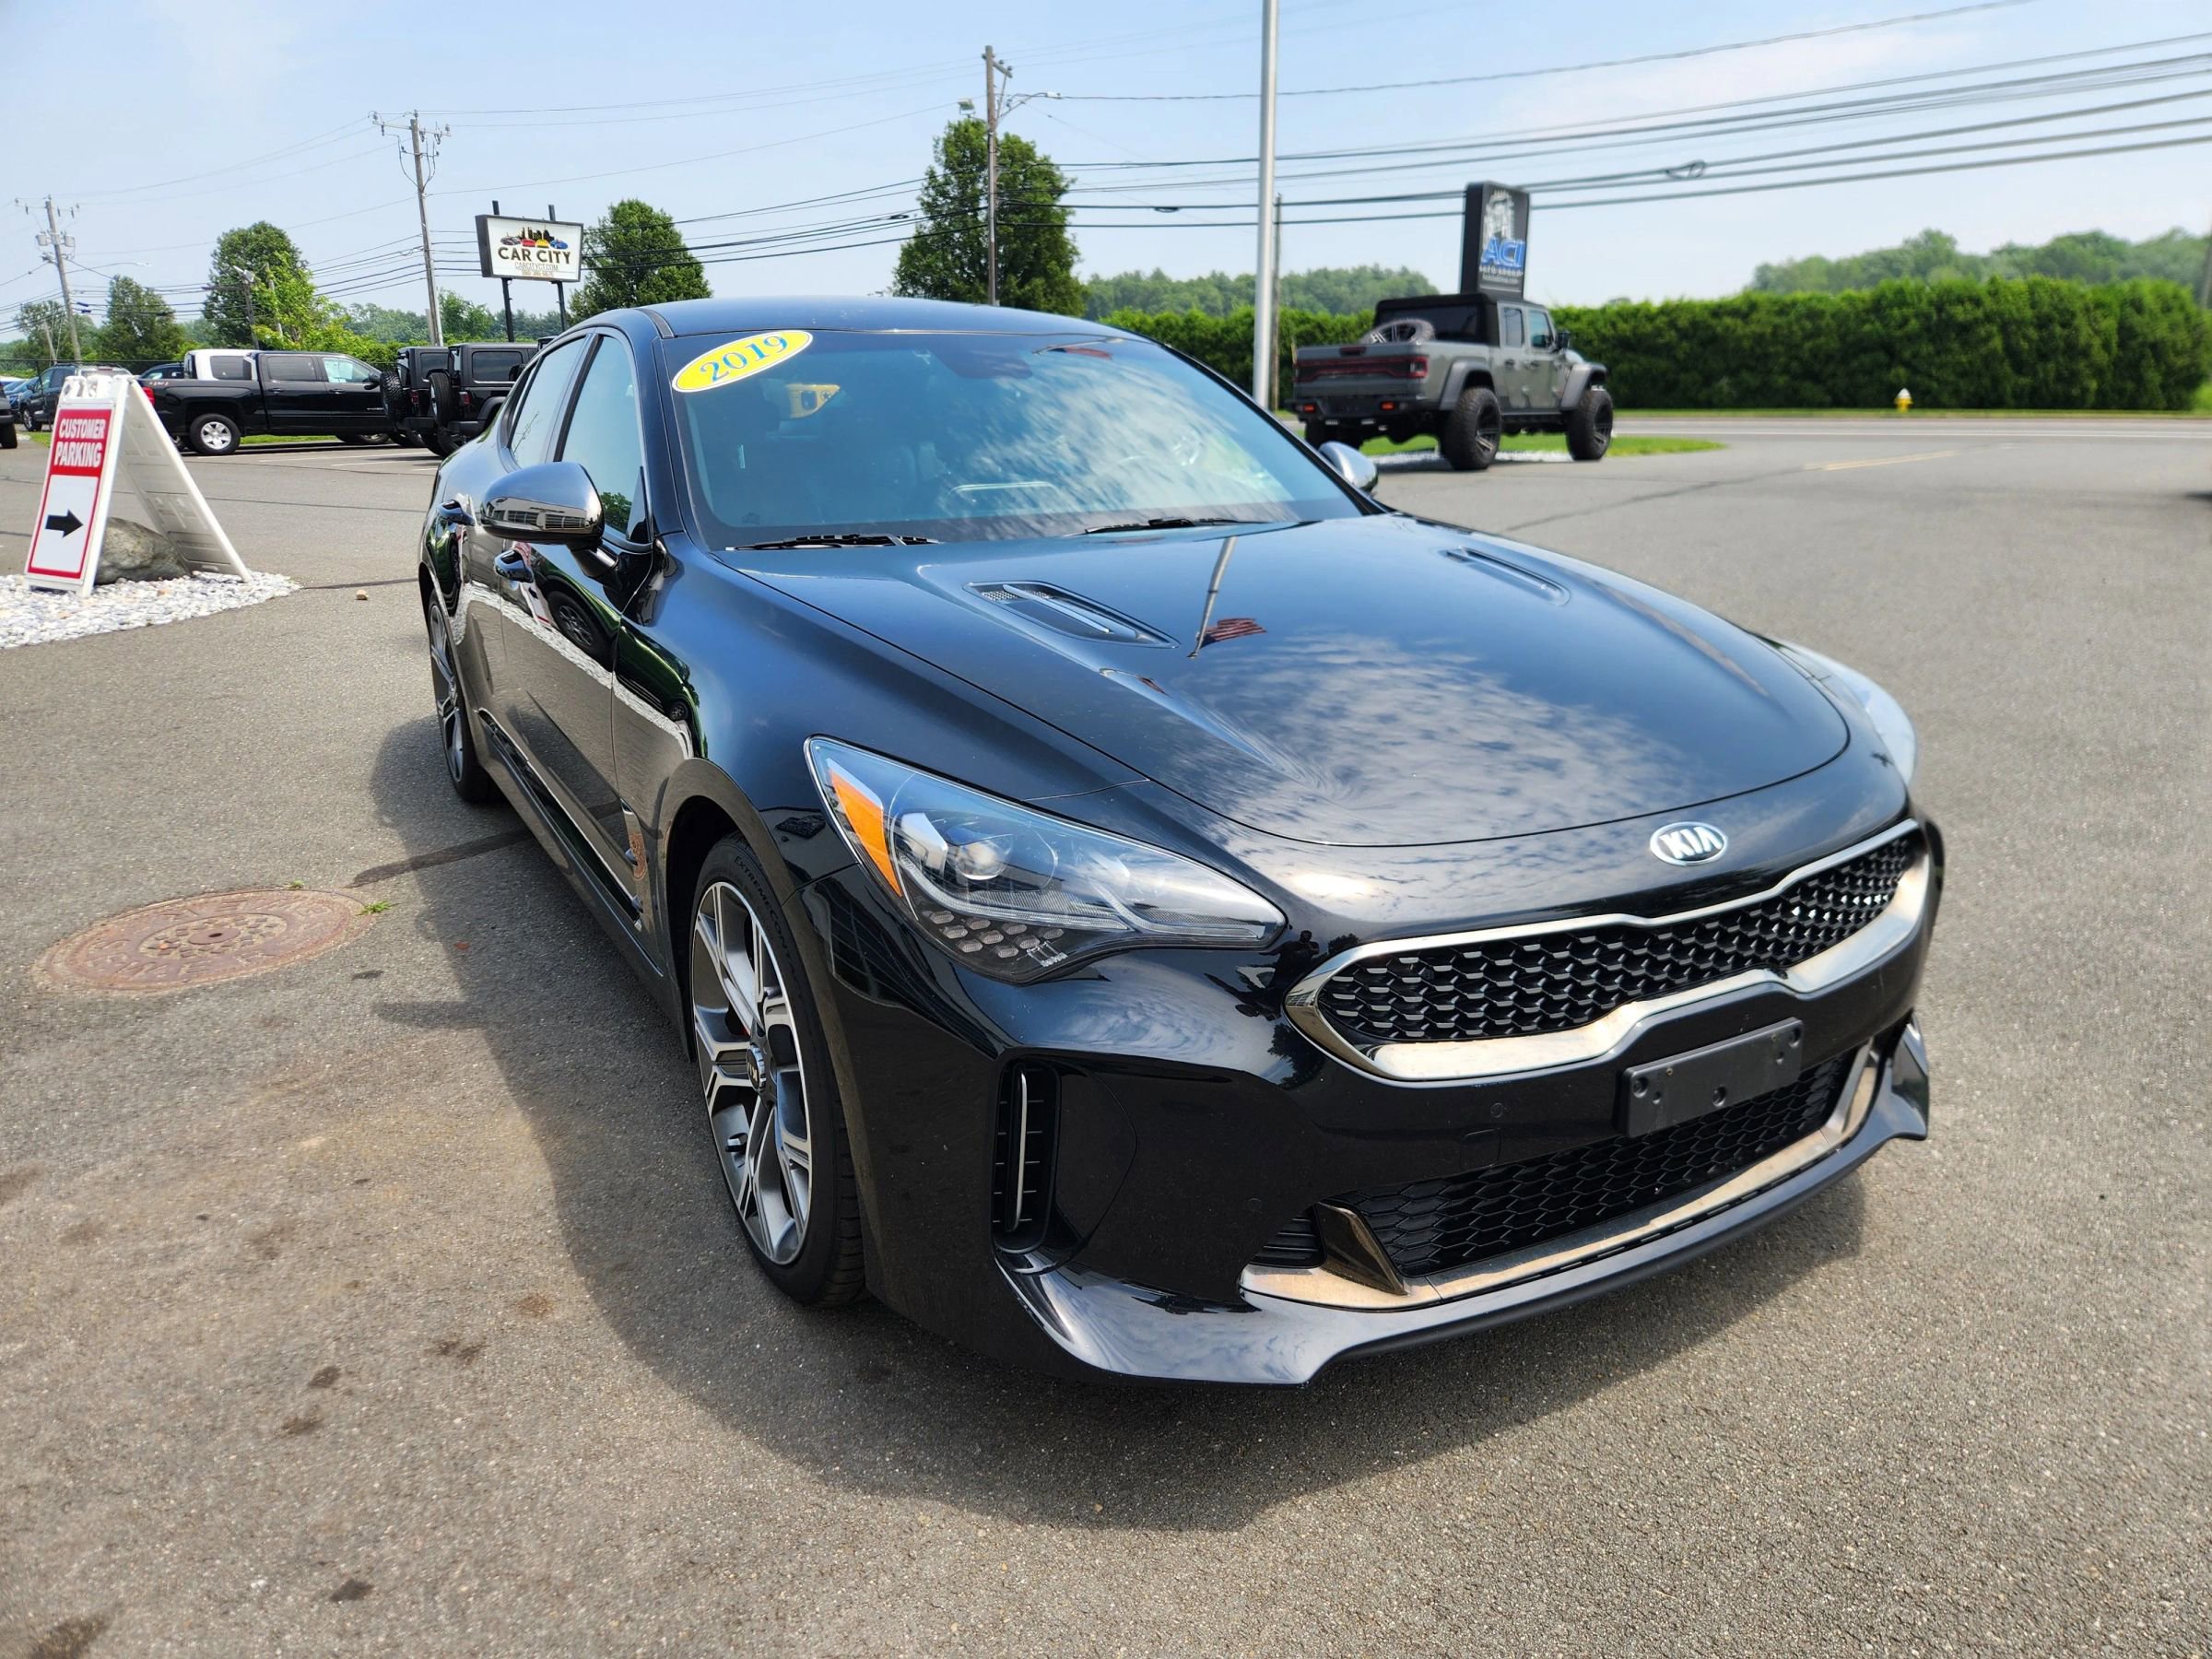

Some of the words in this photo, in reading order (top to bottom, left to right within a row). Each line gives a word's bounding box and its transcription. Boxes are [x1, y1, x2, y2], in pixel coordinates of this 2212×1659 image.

[498, 247, 532, 262] CAR
[535, 249, 571, 265] CITY
[1481, 236, 1526, 268] ACI
[700, 335, 789, 382] 2019
[58, 418, 105, 438] CUSTOMER
[53, 441, 102, 468] PARKING
[1658, 826, 1724, 860] KIA
